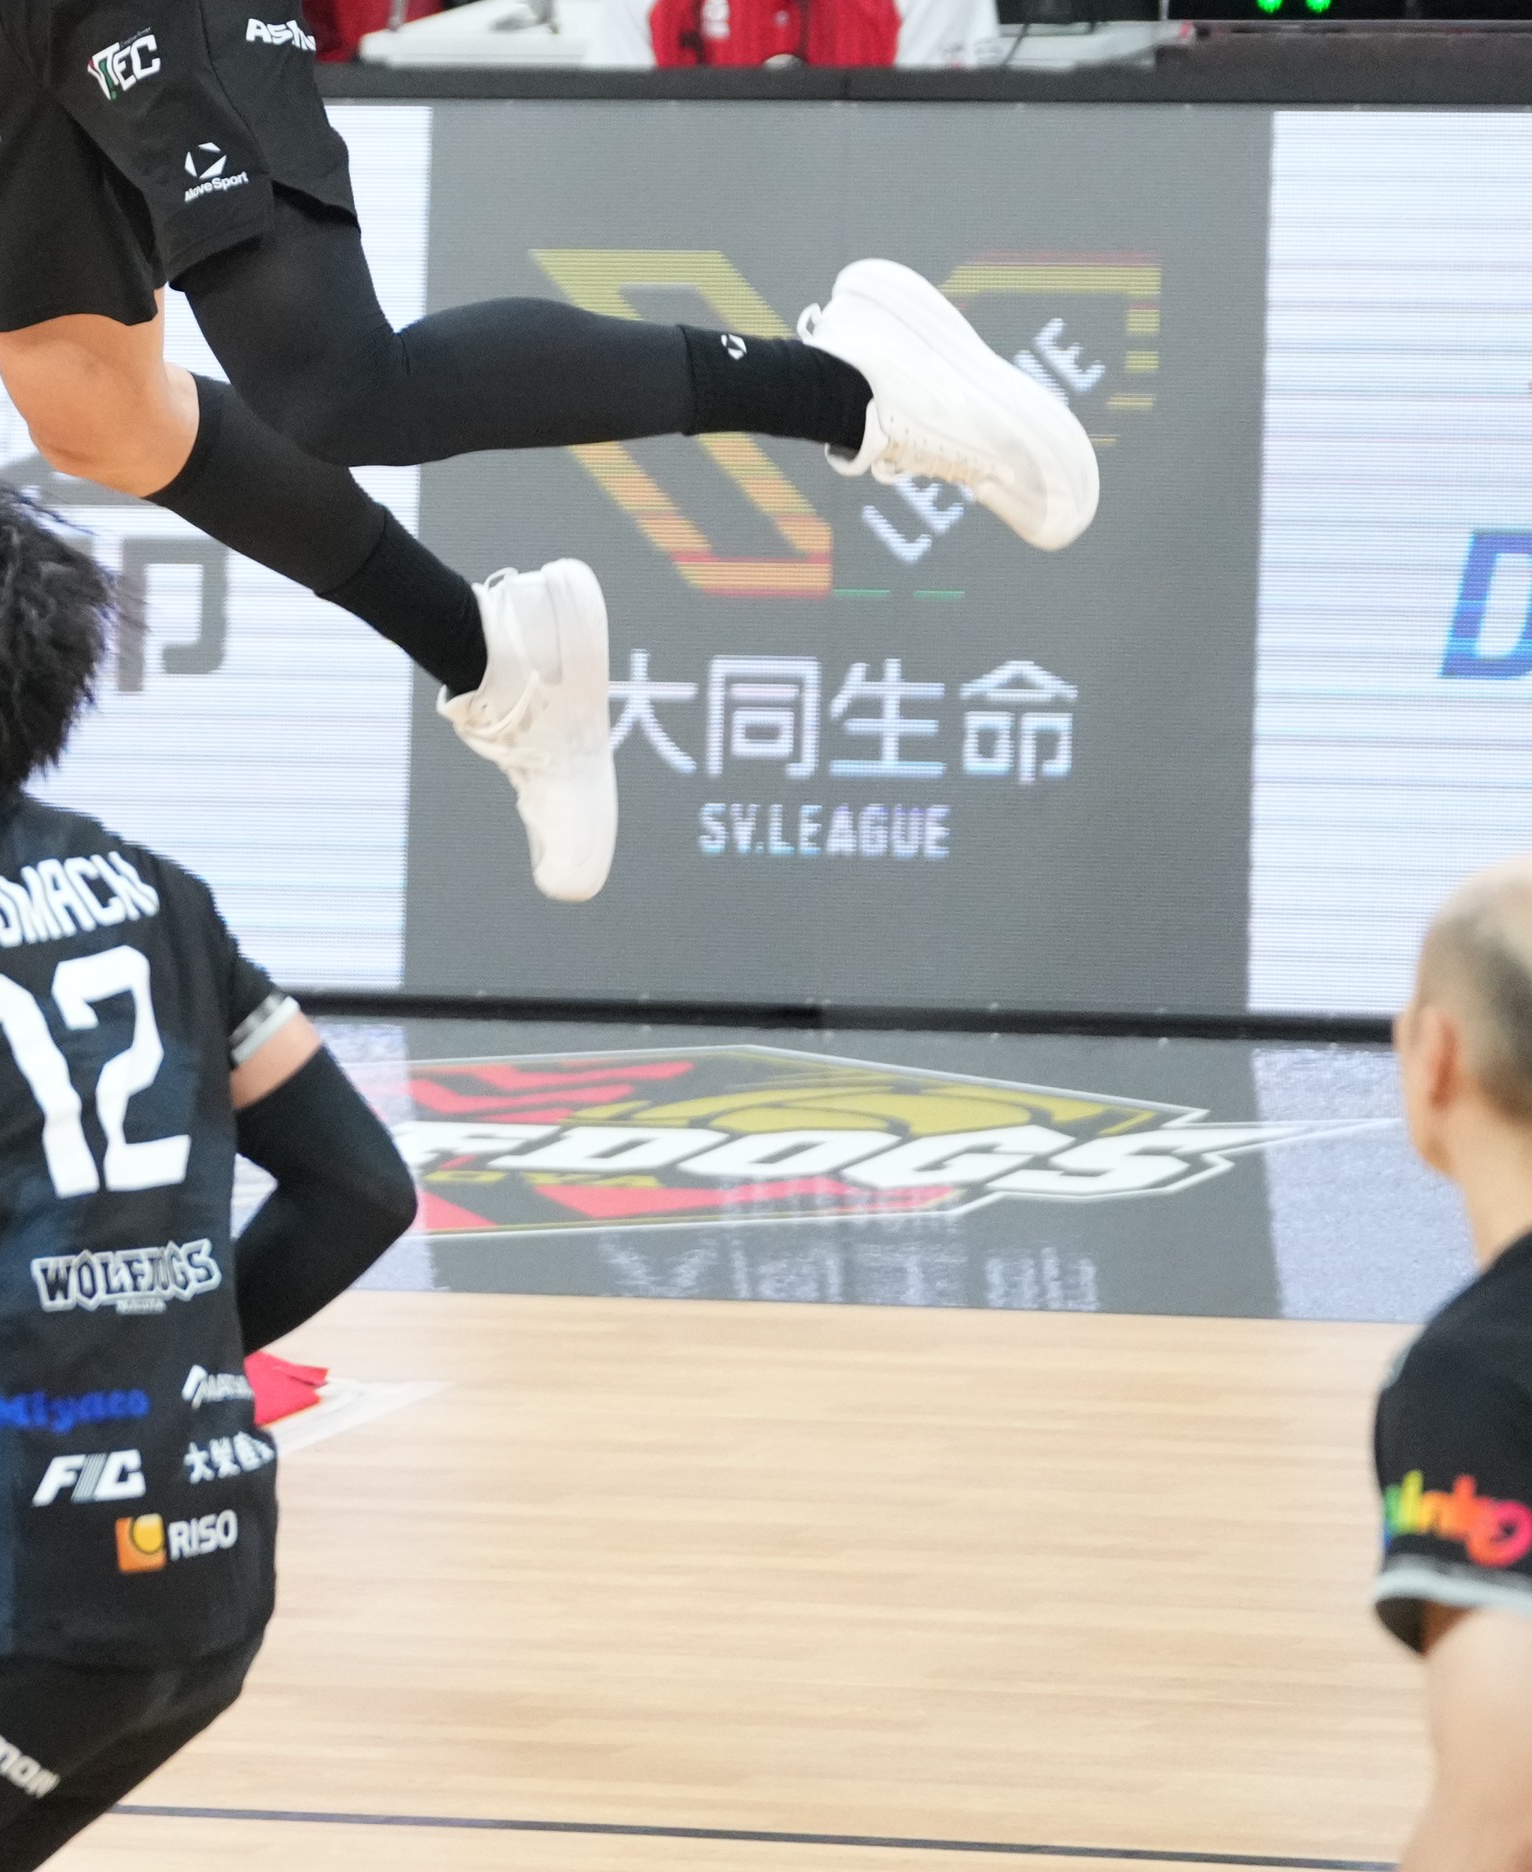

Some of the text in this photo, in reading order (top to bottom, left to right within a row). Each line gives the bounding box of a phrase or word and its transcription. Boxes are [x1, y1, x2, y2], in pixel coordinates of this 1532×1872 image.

[609, 648, 1079, 784] 大同生命
[698, 801, 951, 858] SV.LEAGUE
[168, 1509, 239, 1561] RISO
